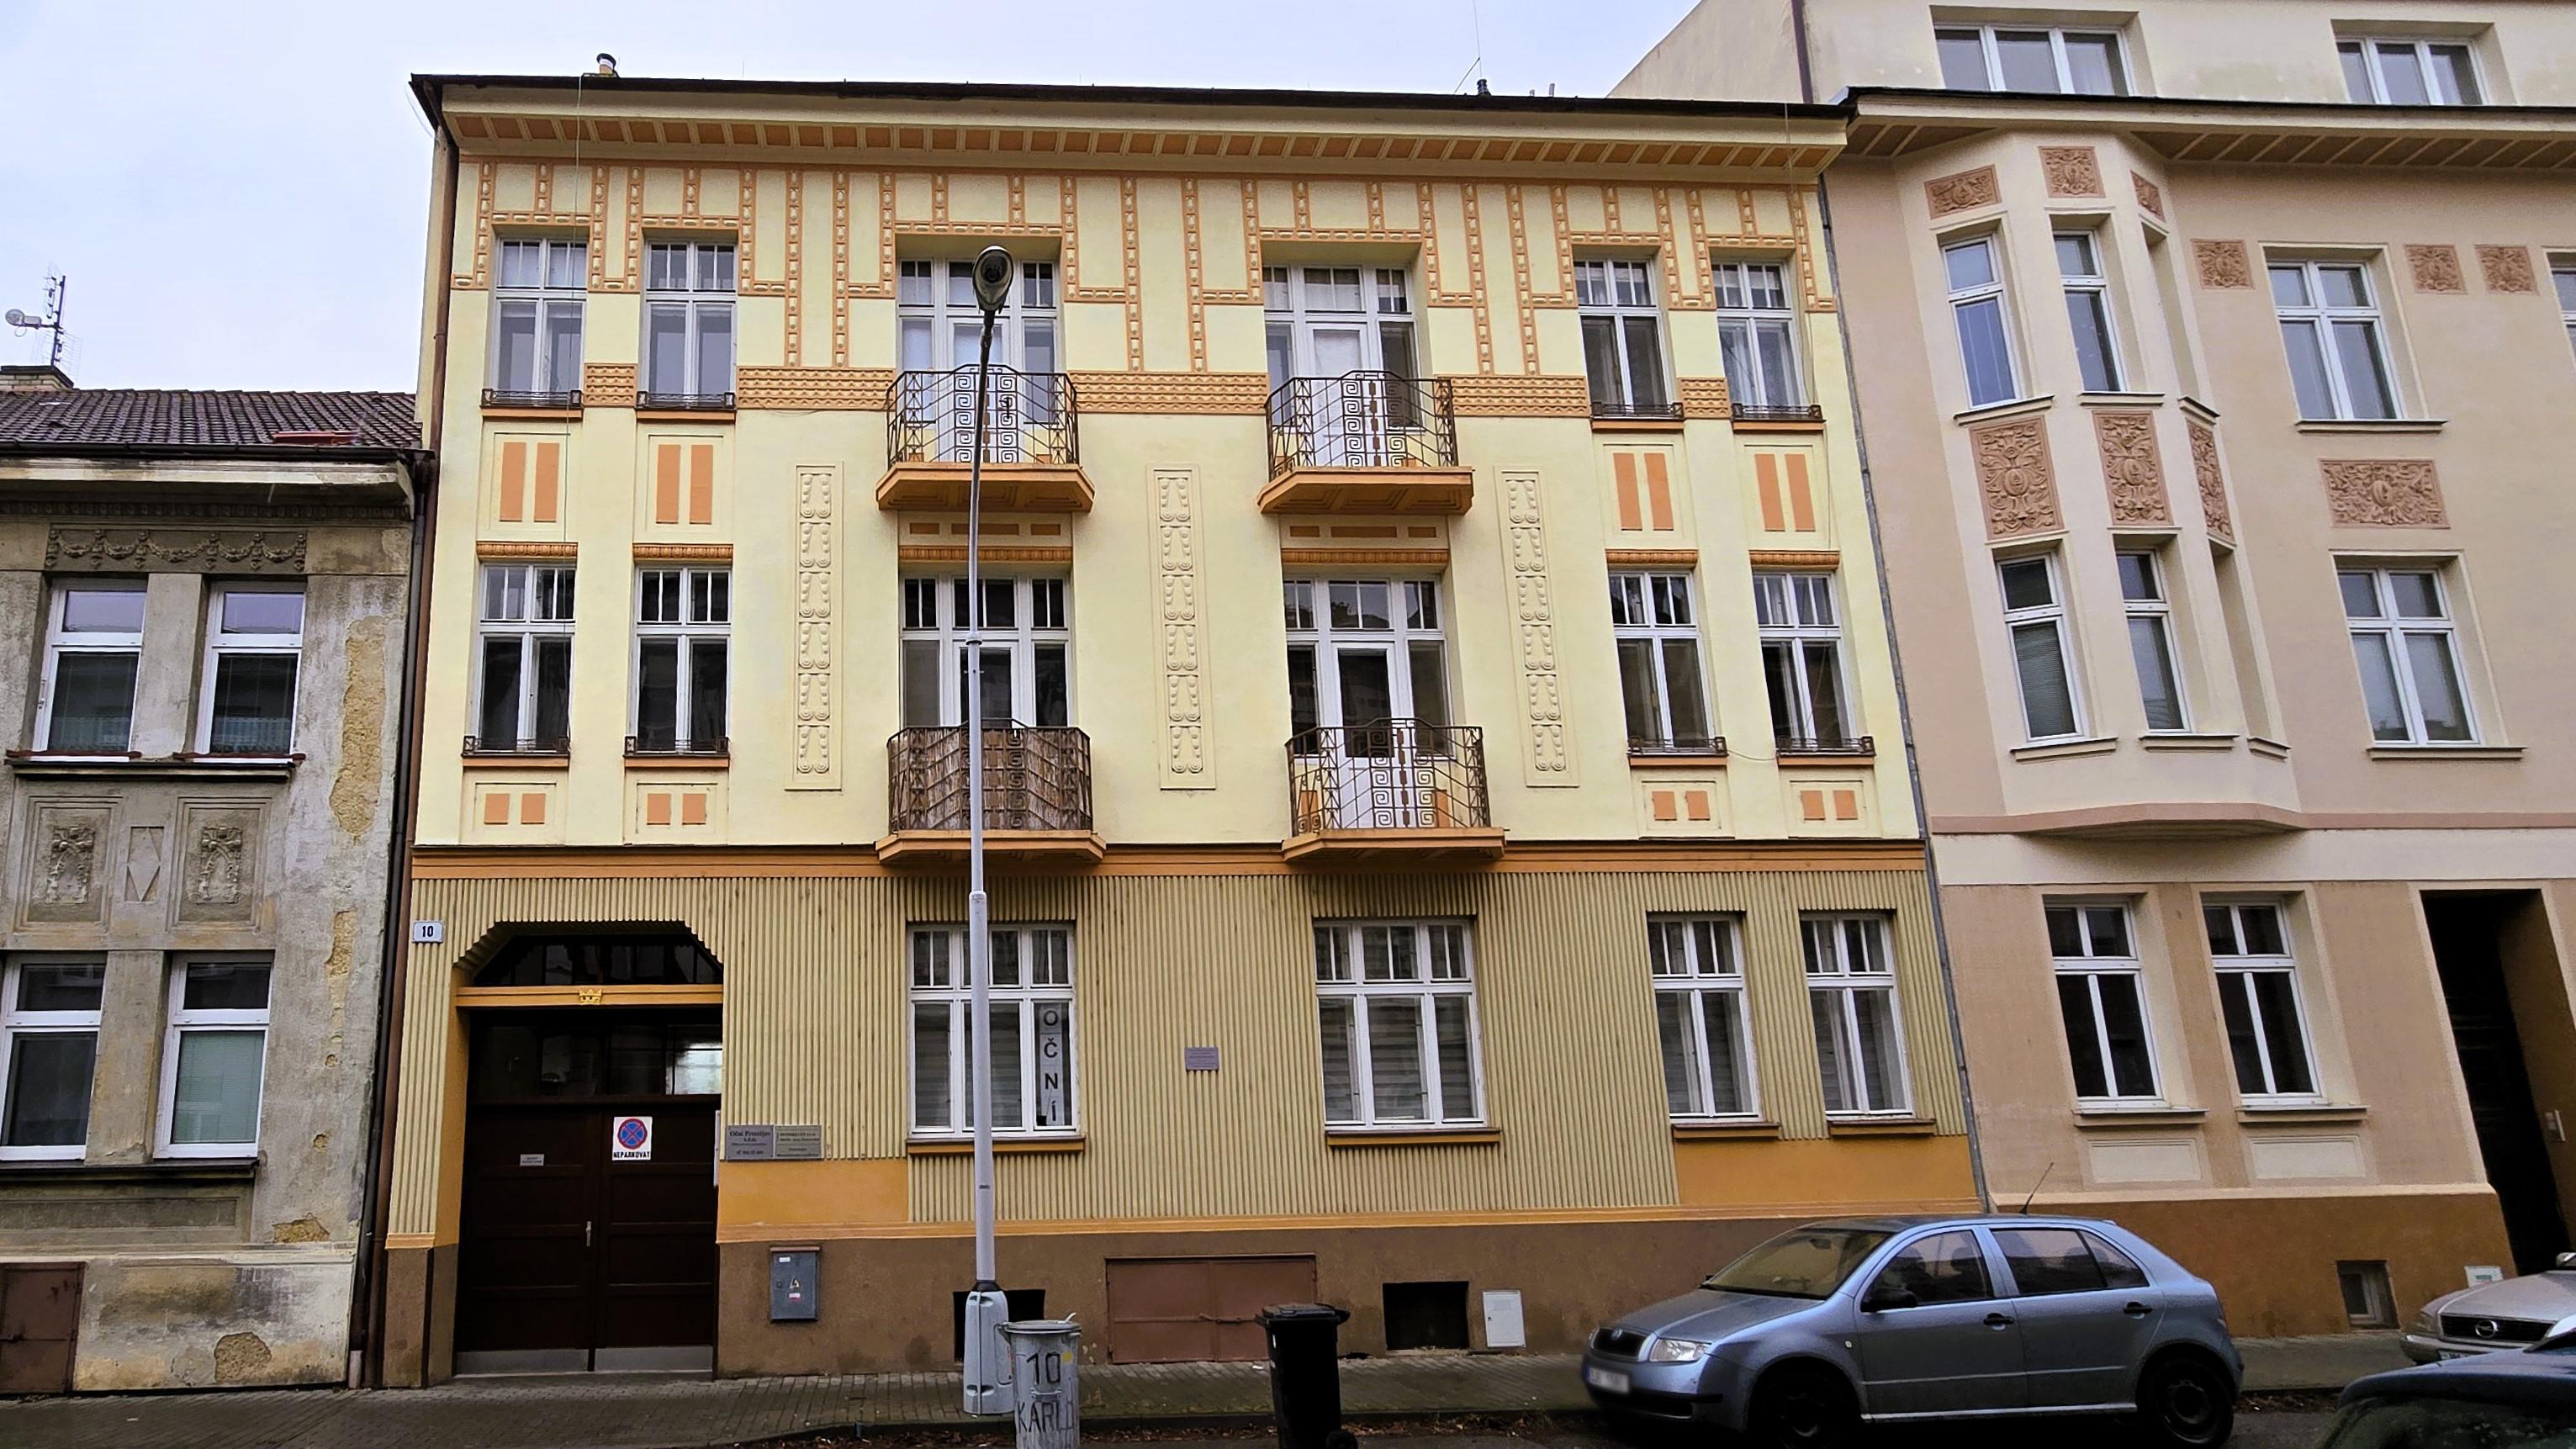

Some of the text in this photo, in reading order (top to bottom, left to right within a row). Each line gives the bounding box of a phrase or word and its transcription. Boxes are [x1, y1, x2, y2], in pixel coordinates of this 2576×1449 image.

[422, 926, 434, 938] 10
[1043, 1010, 1058, 1121] OČNÍ
[1026, 1352, 1061, 1385] 10
